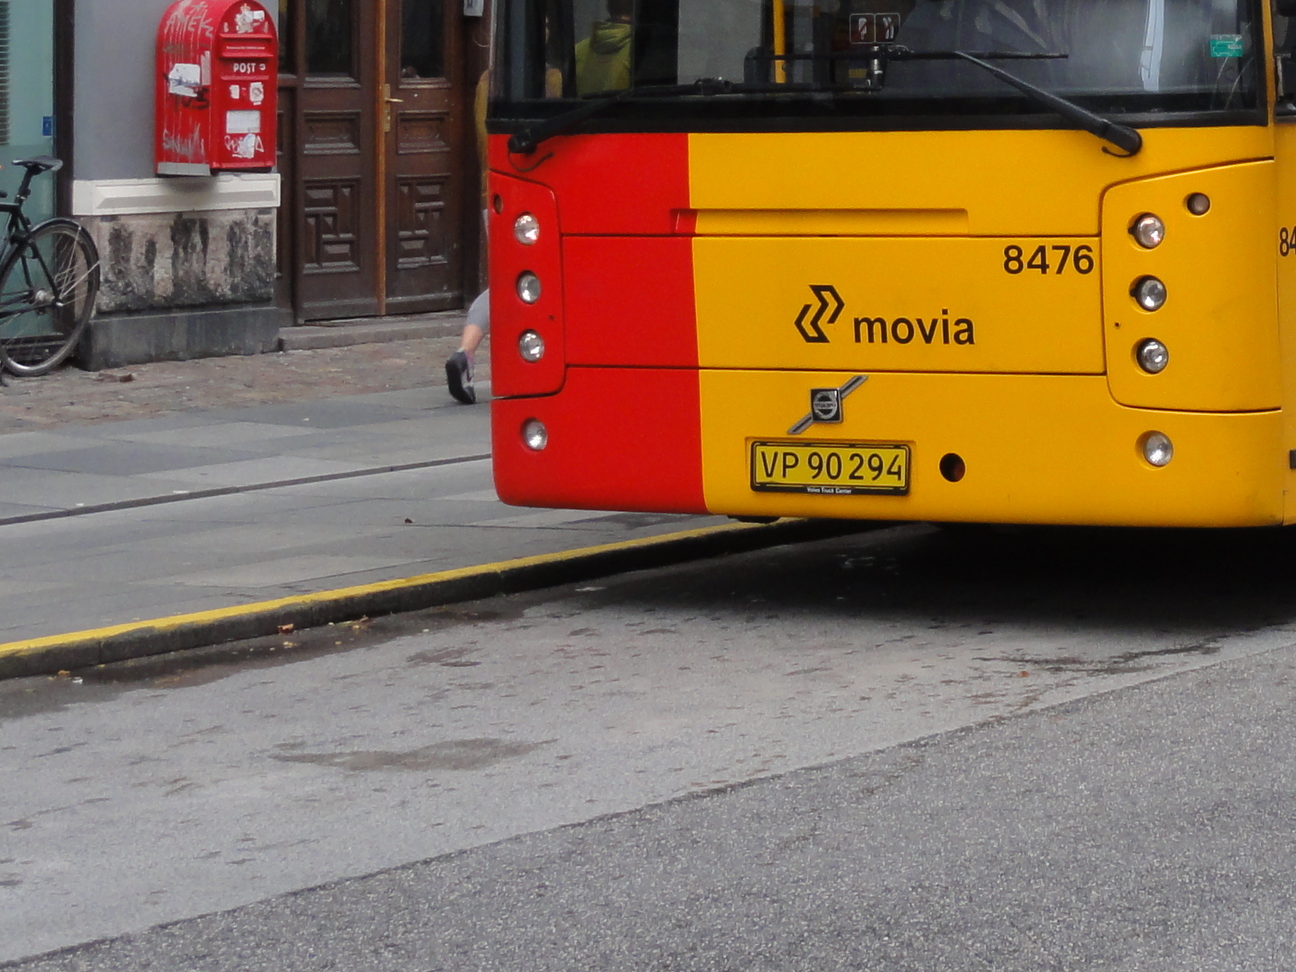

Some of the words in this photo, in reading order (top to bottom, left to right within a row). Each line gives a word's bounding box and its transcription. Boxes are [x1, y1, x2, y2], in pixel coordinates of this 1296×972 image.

[233, 62, 256, 74] POST
[1002, 243, 1095, 276] 8476
[853, 308, 976, 345] movia
[761, 450, 799, 478] VP
[807, 452, 843, 480] 90
[848, 453, 902, 481] 294
